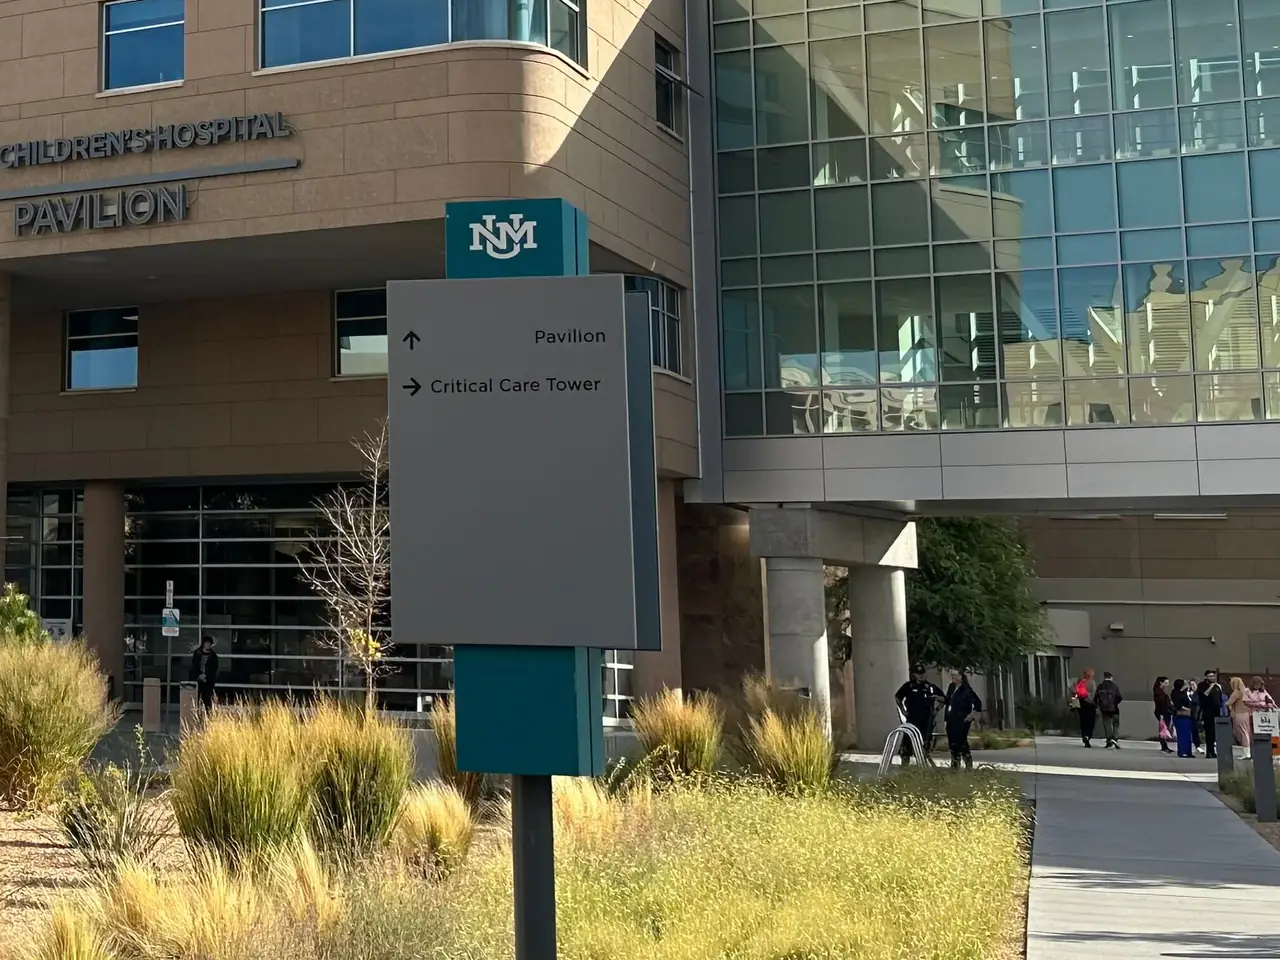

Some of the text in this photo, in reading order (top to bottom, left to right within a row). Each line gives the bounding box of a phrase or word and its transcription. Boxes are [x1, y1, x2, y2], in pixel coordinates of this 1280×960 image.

[152, 112, 291, 151] HOSPITAL
[13, 184, 188, 237] PAVILION
[534, 328, 606, 344] Pavilion
[430, 377, 601, 394] Critical Care Tower
